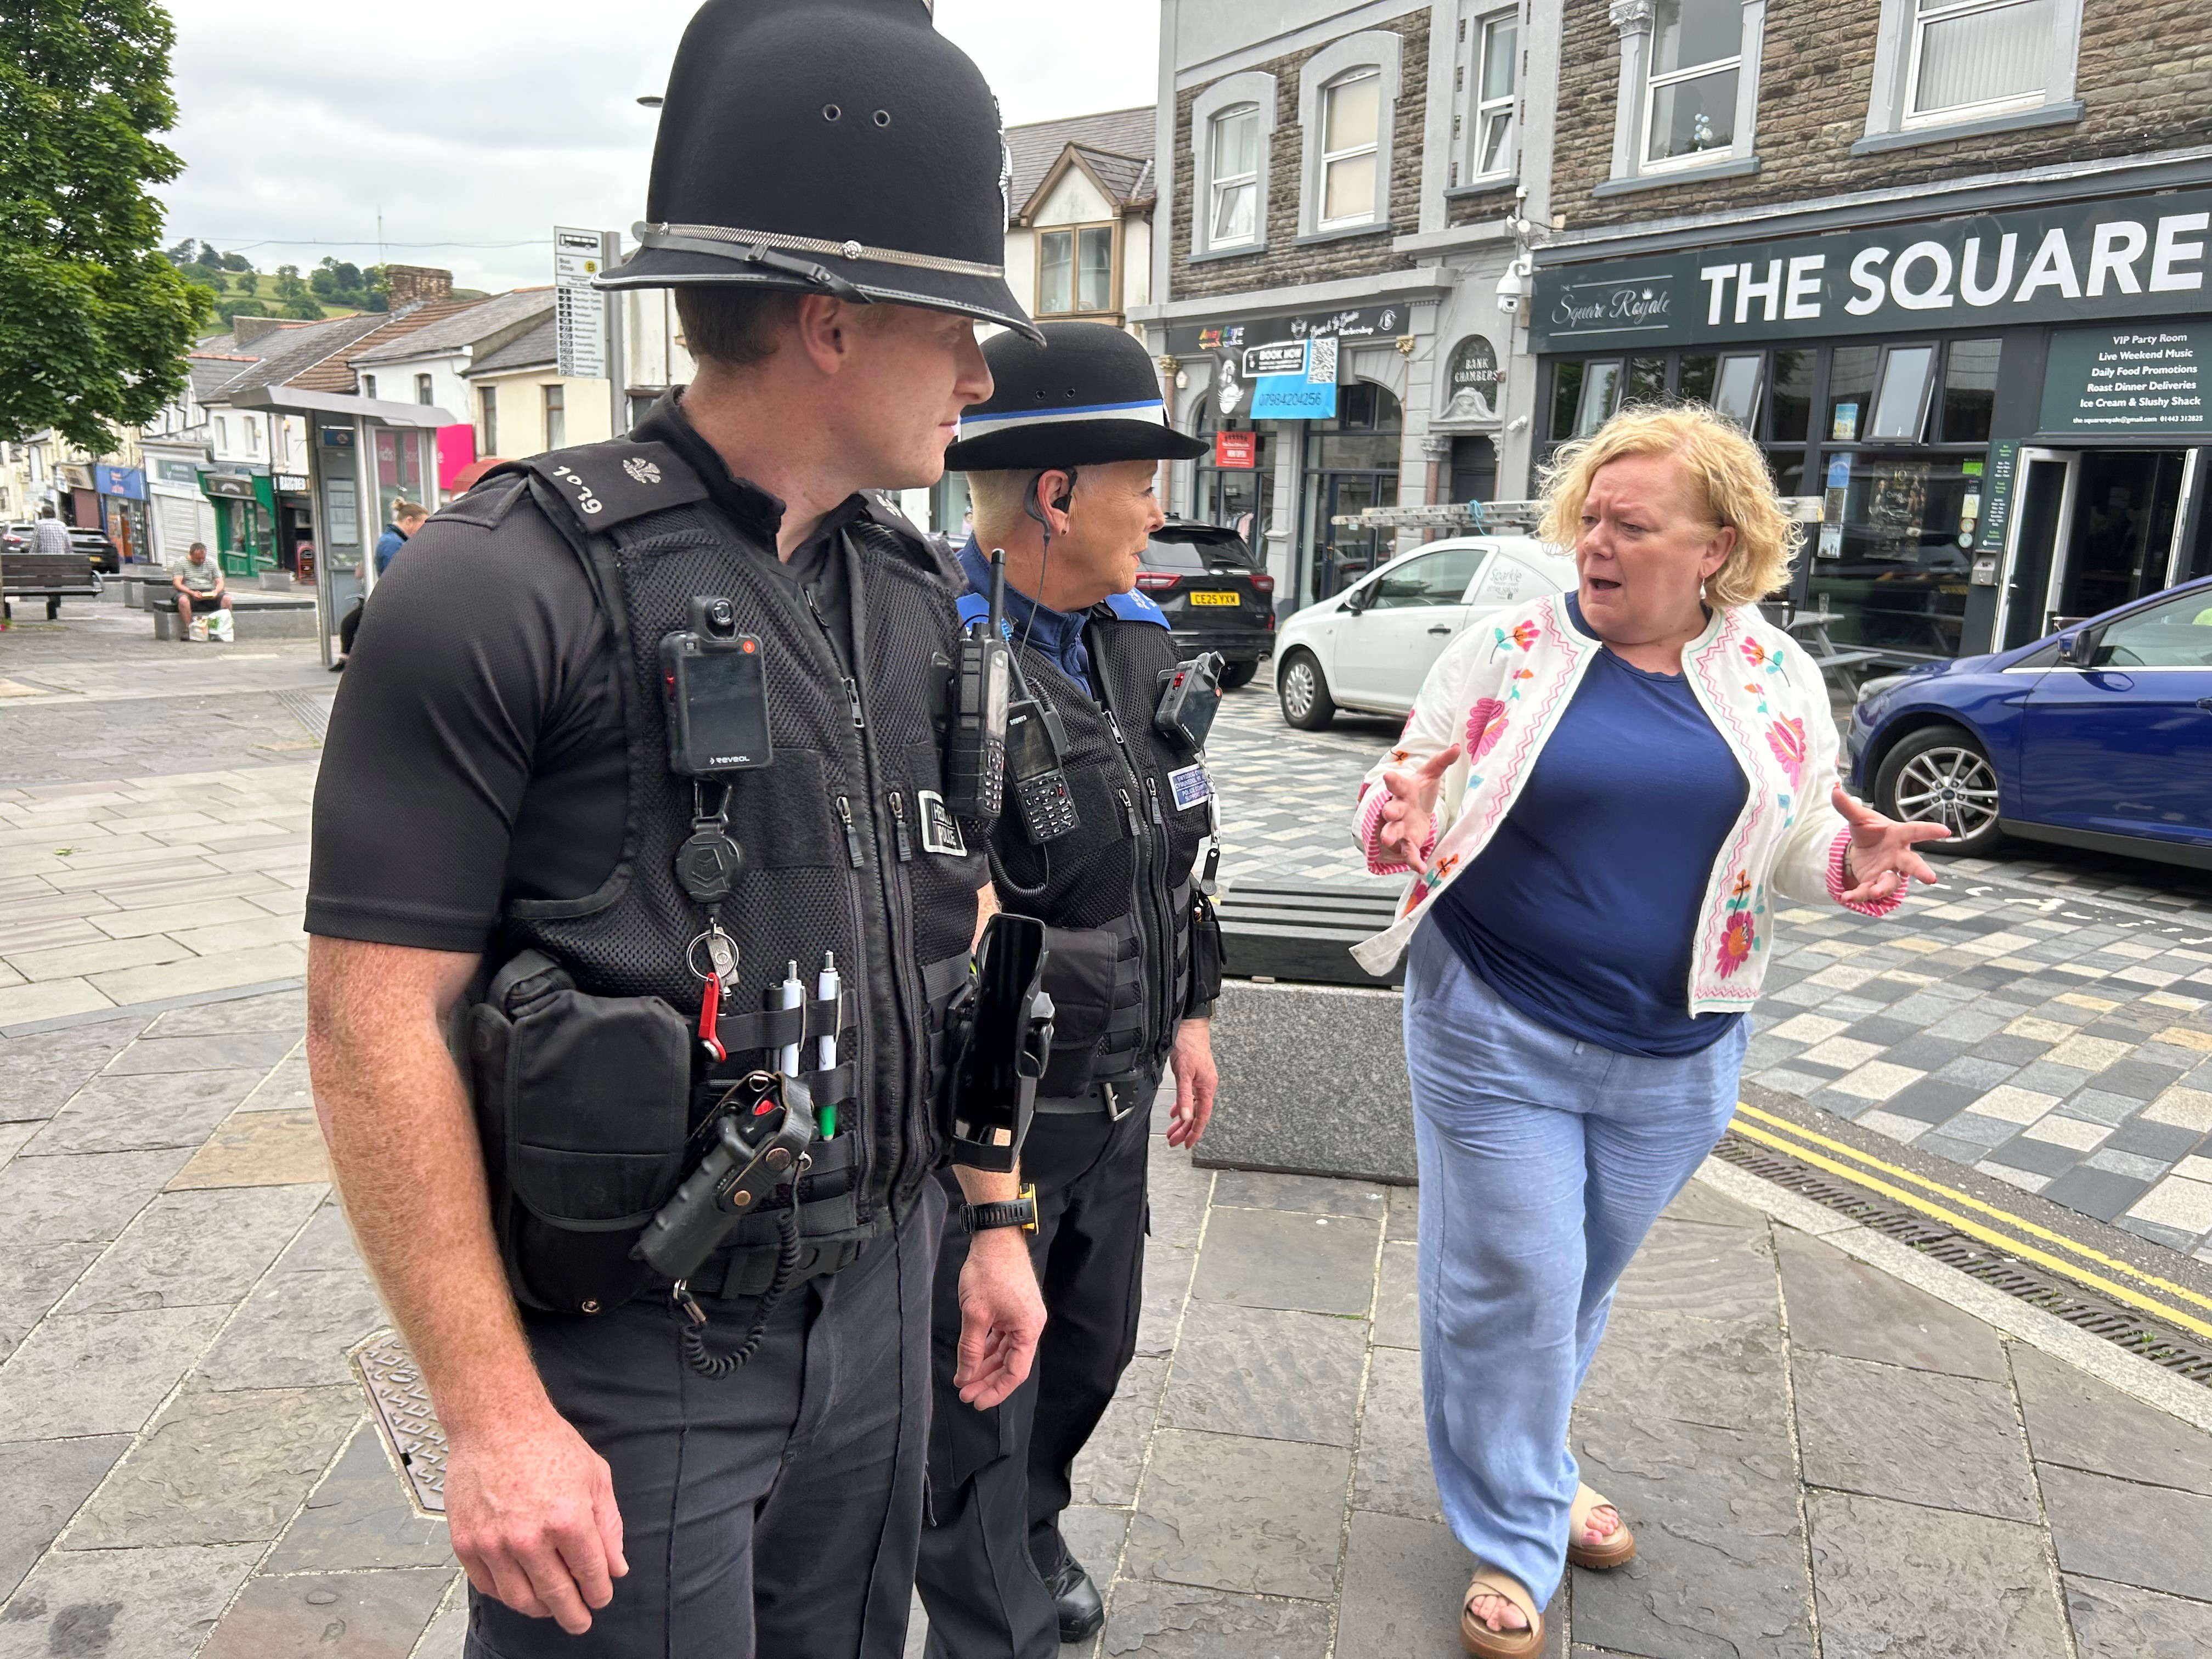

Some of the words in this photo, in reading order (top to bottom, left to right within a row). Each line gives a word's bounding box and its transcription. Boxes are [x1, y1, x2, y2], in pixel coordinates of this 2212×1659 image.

[1700, 253, 1826, 326] THE
[1844, 211, 2211, 317] SQUARE
[1551, 294, 1607, 328] Square
[1609, 289, 1671, 325] Royale
[2113, 336, 2130, 345] VIP
[2131, 335, 2158, 345] Party
[2159, 334, 2187, 342] Room
[1259, 349, 1284, 360] BOOK
[2098, 352, 2118, 362] Live
[2119, 349, 2163, 360] Weekend
[2165, 348, 2193, 358] Music
[1465, 358, 1489, 370] BANK
[1454, 369, 1498, 383] CHAMBERS
[2091, 367, 2115, 379] Daily
[2117, 366, 2140, 376] Food
[2142, 365, 2198, 375] Promotions
[2087, 383, 2113, 392] Roast
[2114, 382, 2147, 392] Dinner
[2149, 380, 2197, 391] Deliveries
[1259, 392, 1322, 406] 07984204256
[2080, 399, 2094, 408] Ice
[2096, 398, 2126, 408] Cream
[2128, 397, 2136, 406] &
[2138, 397, 2169, 408] Slushy
[2171, 396, 2201, 406] Shack
[1195, 594, 1217, 605] CE25
[1009, 715, 1028, 726] sepura
